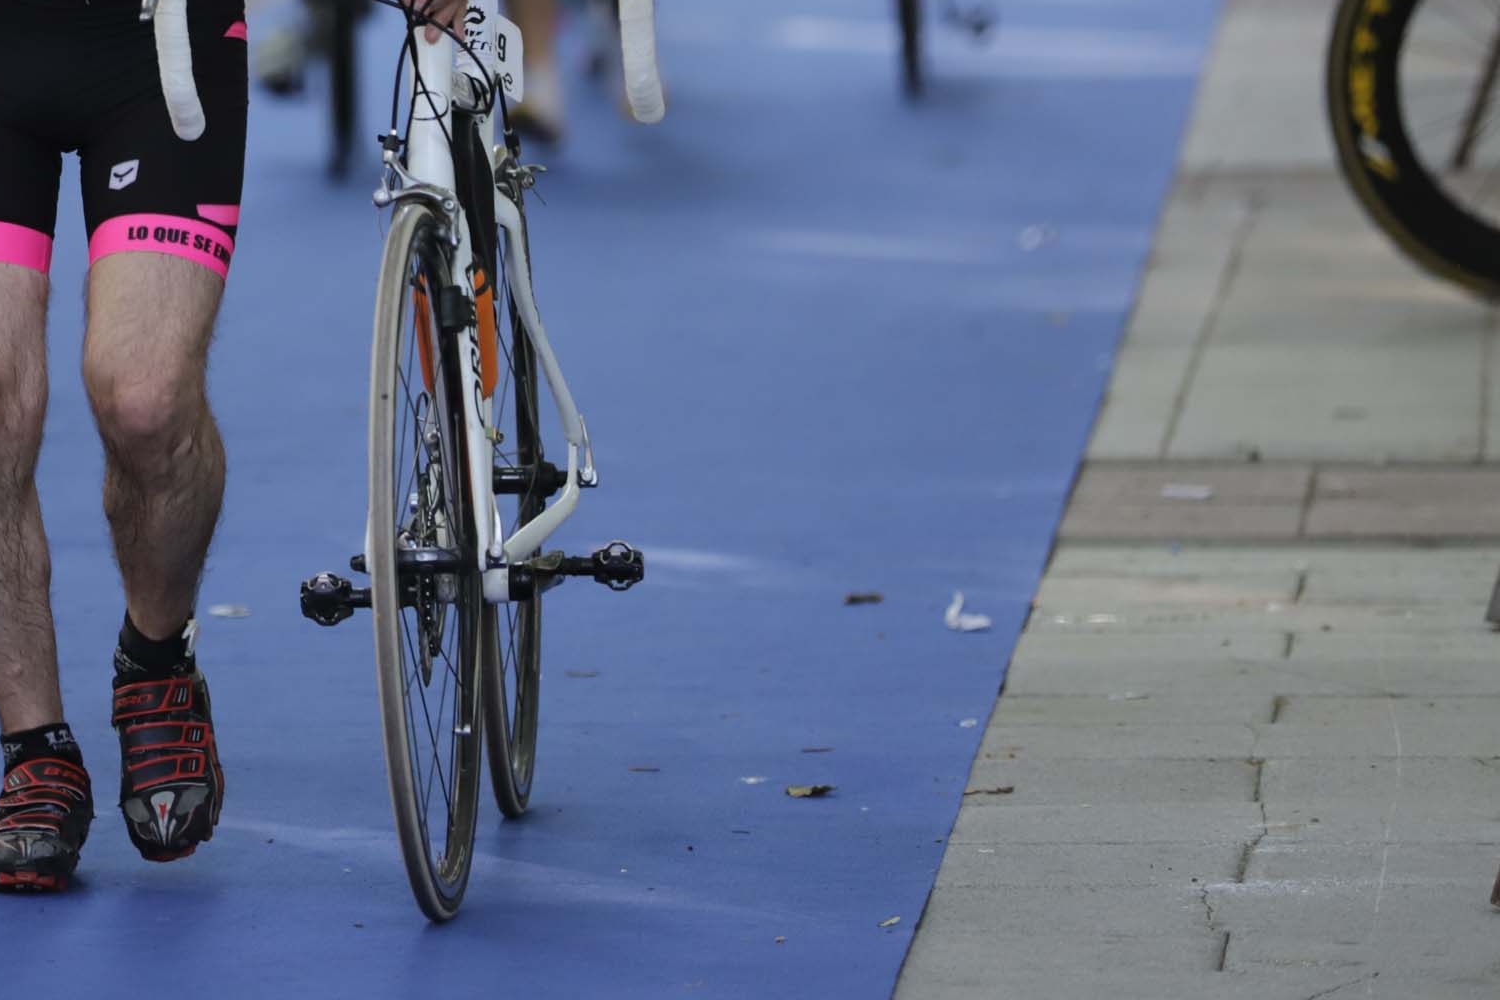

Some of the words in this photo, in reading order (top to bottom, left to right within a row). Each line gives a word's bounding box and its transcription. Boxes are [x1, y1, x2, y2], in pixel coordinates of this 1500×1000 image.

[128, 226, 149, 241] LO
[153, 226, 190, 246] QUE
[193, 234, 212, 254] SE
